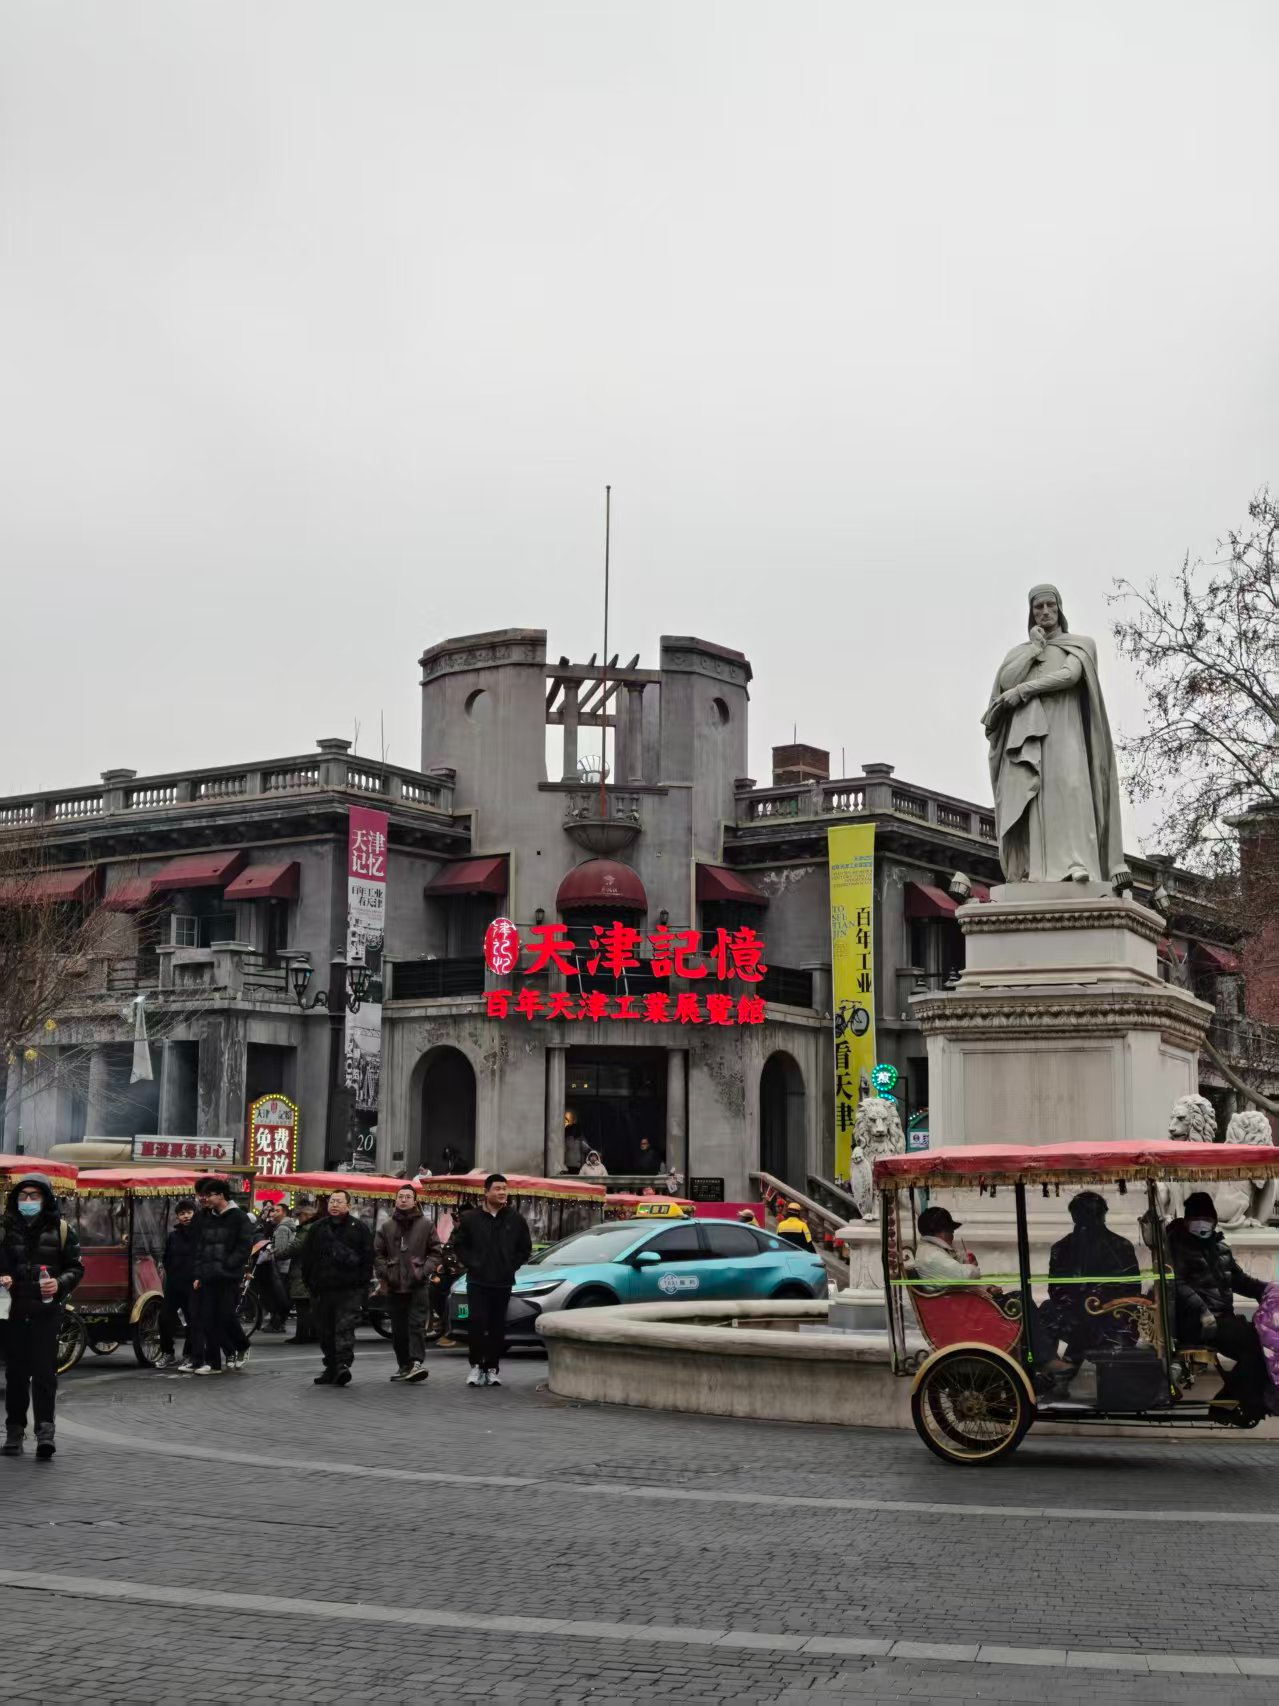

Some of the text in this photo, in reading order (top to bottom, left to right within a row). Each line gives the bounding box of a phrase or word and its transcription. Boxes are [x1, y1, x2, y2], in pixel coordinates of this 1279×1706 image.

[351, 829, 385, 854] 天津
[351, 850, 385, 877] 记忆
[524, 920, 768, 982] 天津記憶
[856, 906, 872, 993] 百年工业
[256, 1127, 290, 1153] 免费
[255, 1154, 289, 1177] 开放
